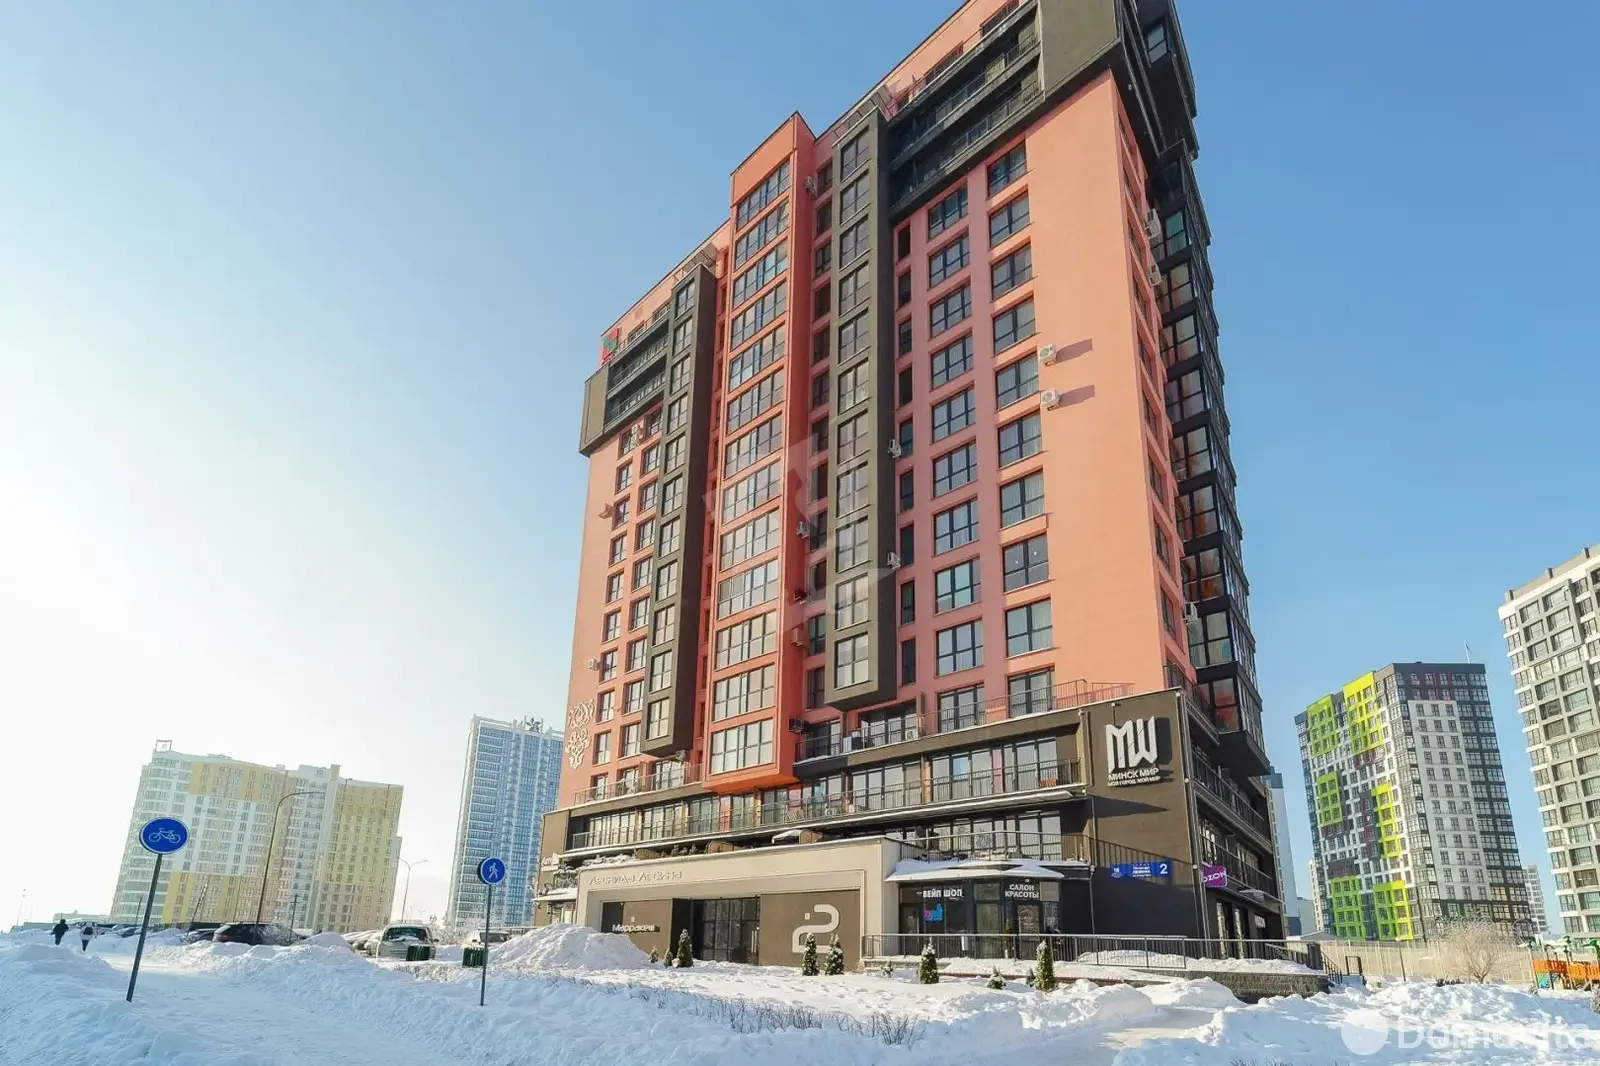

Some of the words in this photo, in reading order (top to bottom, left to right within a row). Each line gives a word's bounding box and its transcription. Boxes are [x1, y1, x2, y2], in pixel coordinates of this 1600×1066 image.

[1108, 770, 1138, 781] МИНСК
[1140, 767, 1159, 777] МИР
[1159, 863, 1168, 875] 2
[1009, 883, 1035, 891] САЛОН
[922, 888, 942, 898] ВЕЙП
[943, 888, 963, 898] ШОП
[1004, 890, 1040, 899] КРАСОТЫ
[791, 903, 840, 954] 2
